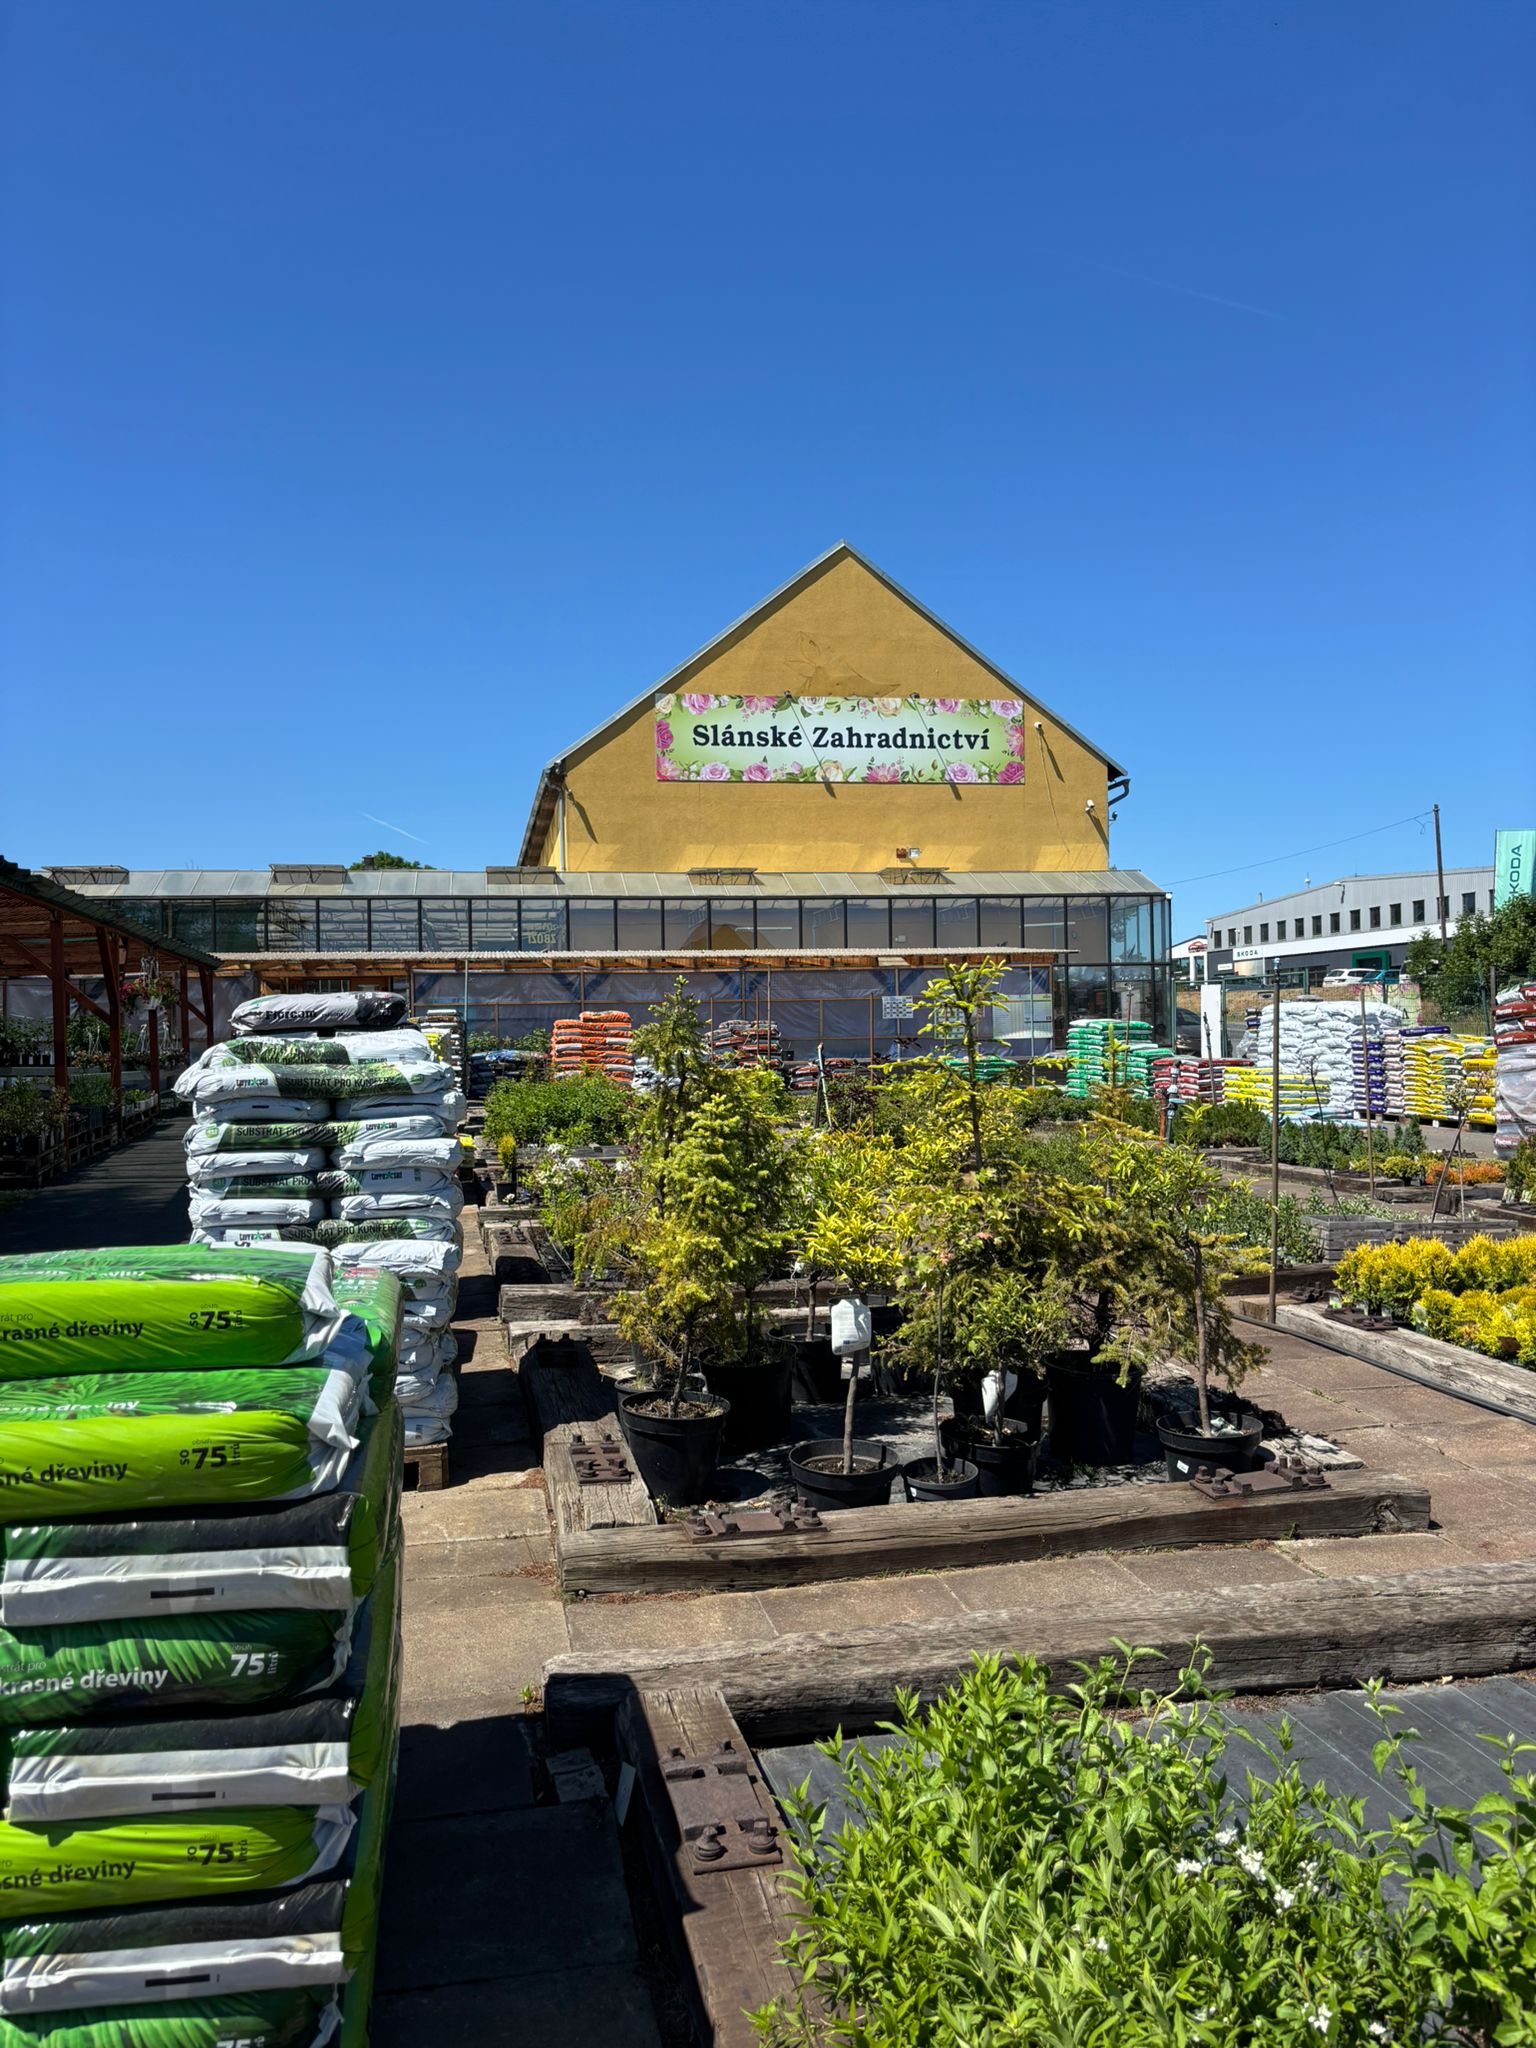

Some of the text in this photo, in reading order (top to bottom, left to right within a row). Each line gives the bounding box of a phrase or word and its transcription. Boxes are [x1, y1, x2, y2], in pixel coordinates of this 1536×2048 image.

[692, 723, 990, 751] Slánské Zahradnictví
[1509, 844, 1522, 895] KODA
[334, 1078, 351, 1088] PRO
[292, 1176, 310, 1186] PRO
[338, 1226, 355, 1237] PRO
[16, 1312, 33, 1323] pro
[66, 1319, 144, 1339] dřeviny
[200, 1310, 231, 1331] 75
[191, 1446, 227, 1470] 75
[40, 1460, 128, 1483] dřeviny
[27, 1660, 47, 1674] pro
[231, 1652, 265, 1677] 75
[80, 1666, 168, 1689] dřeviny
[199, 1842, 234, 1865] 75
[48, 1859, 136, 1885] dřeviny
